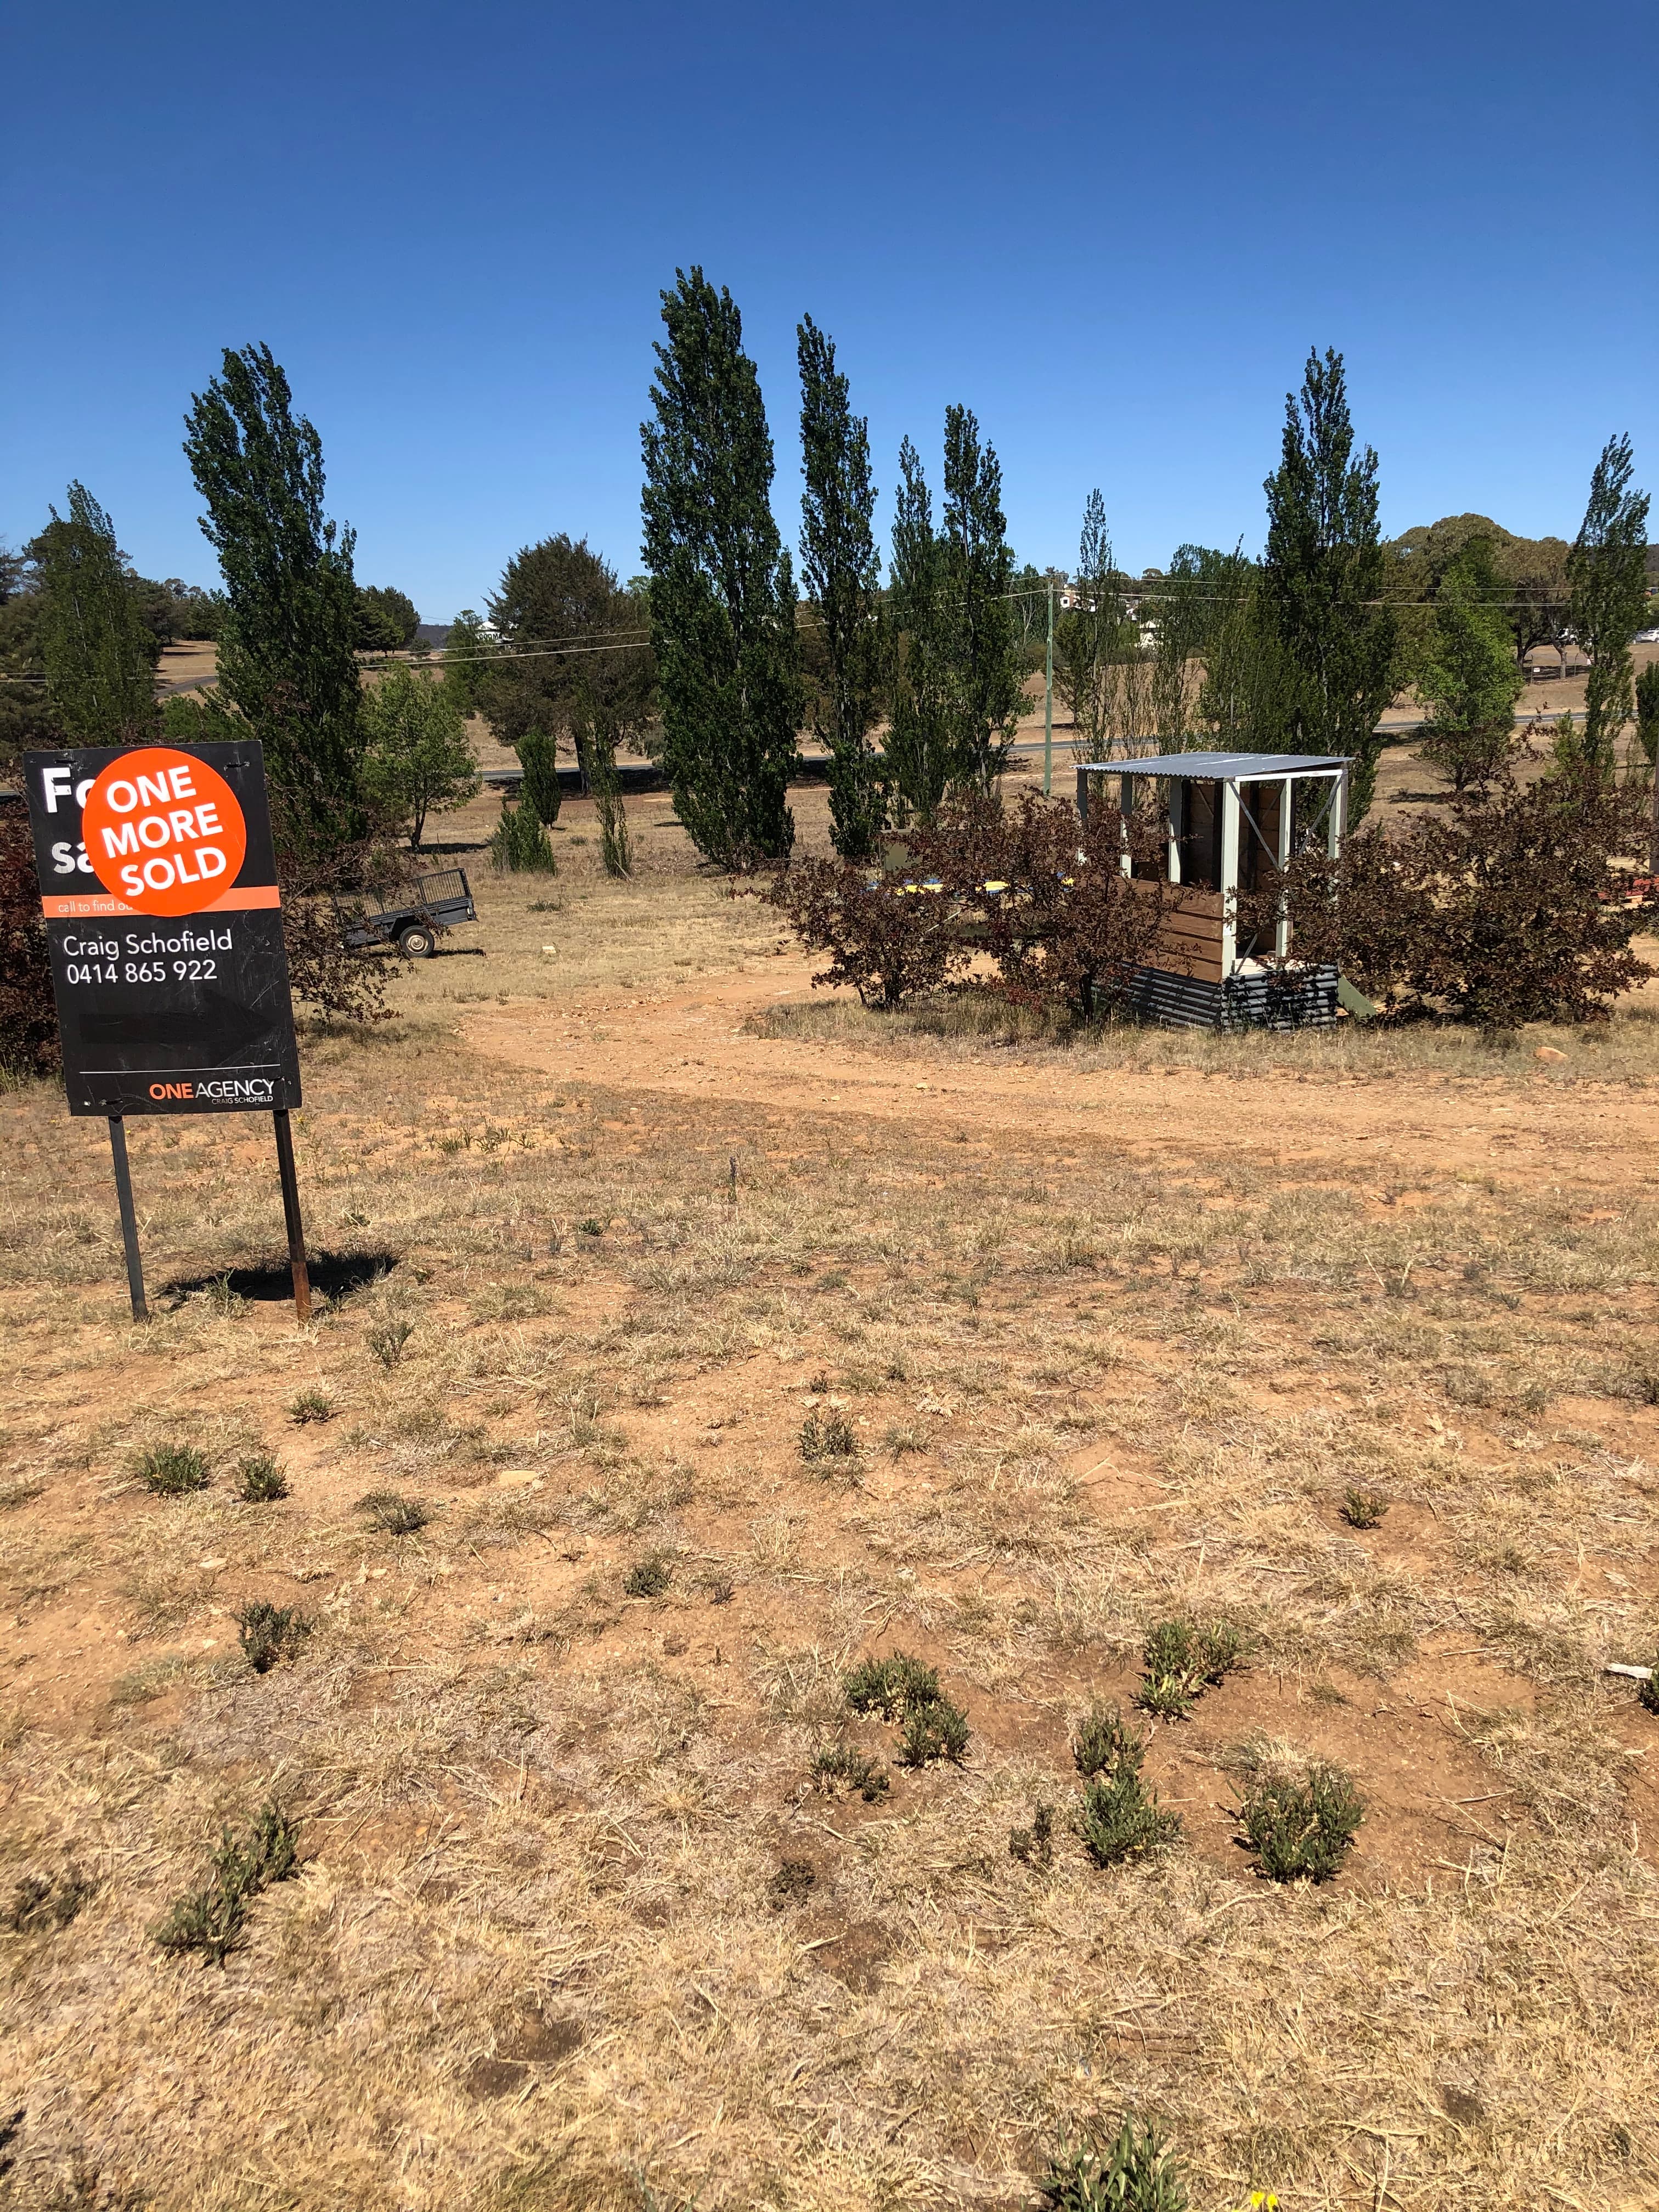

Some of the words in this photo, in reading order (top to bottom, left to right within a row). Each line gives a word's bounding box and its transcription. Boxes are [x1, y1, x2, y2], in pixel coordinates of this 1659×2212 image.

[106, 765, 197, 813] ONE
[101, 803, 224, 859] MORE
[121, 847, 227, 896] SOLD
[58, 901, 76, 913] call
[78, 902, 90, 913] to
[92, 899, 115, 912] find
[64, 935, 120, 961] Craig
[126, 928, 233, 955] Schofield
[66, 963, 119, 984] 0414
[125, 962, 166, 983] 865
[173, 959, 218, 981] 922
[234, 1096, 274, 1104] SCHOFIELD
